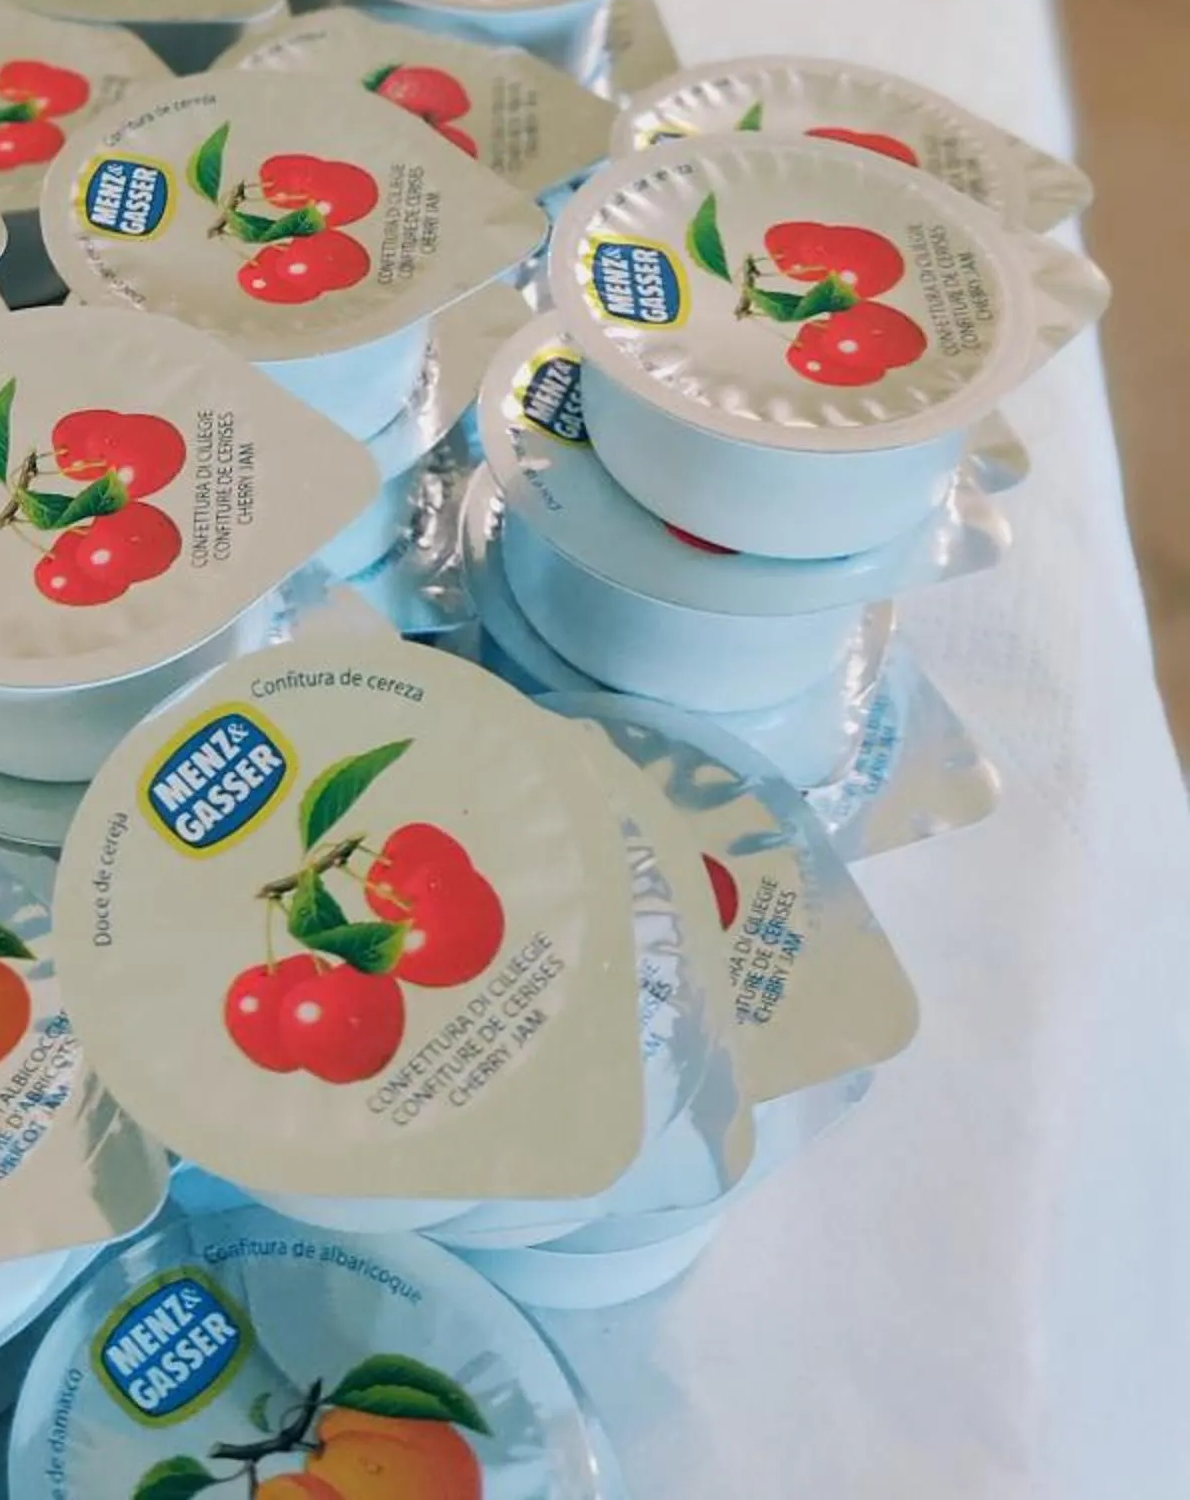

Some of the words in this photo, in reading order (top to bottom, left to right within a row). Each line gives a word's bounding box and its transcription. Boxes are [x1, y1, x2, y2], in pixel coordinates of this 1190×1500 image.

[119, 167, 158, 234] GASSER
[632, 248, 670, 322] GASSER
[238, 441, 255, 470] JAM
[237, 475, 255, 526] CHERRY
[251, 670, 336, 699] Confitura
[340, 668, 364, 687] de
[367, 676, 426, 703] cereza
[174, 743, 283, 842] GASSER
[100, 811, 129, 869] cereja
[93, 869, 111, 896] de
[94, 899, 111, 947] Doce
[761, 890, 797, 947] CERISES
[751, 947, 773, 972] DE
[366, 1014, 476, 1114] CONFETTURA
[466, 993, 492, 1019] DI
[486, 930, 553, 998] CILIEGIE
[752, 965, 791, 1025] CHERRY
[391, 1039, 484, 1126] CONFITURE
[477, 1014, 507, 1044] DE
[502, 953, 565, 1019] CERISES
[447, 1043, 512, 1108] CHERRY
[511, 1008, 548, 1049] JAM
[203, 1237, 288, 1265] Confitura
[292, 1240, 316, 1261] de
[319, 1242, 424, 1305] albaricoque
[128, 1311, 238, 1412] GASSER
